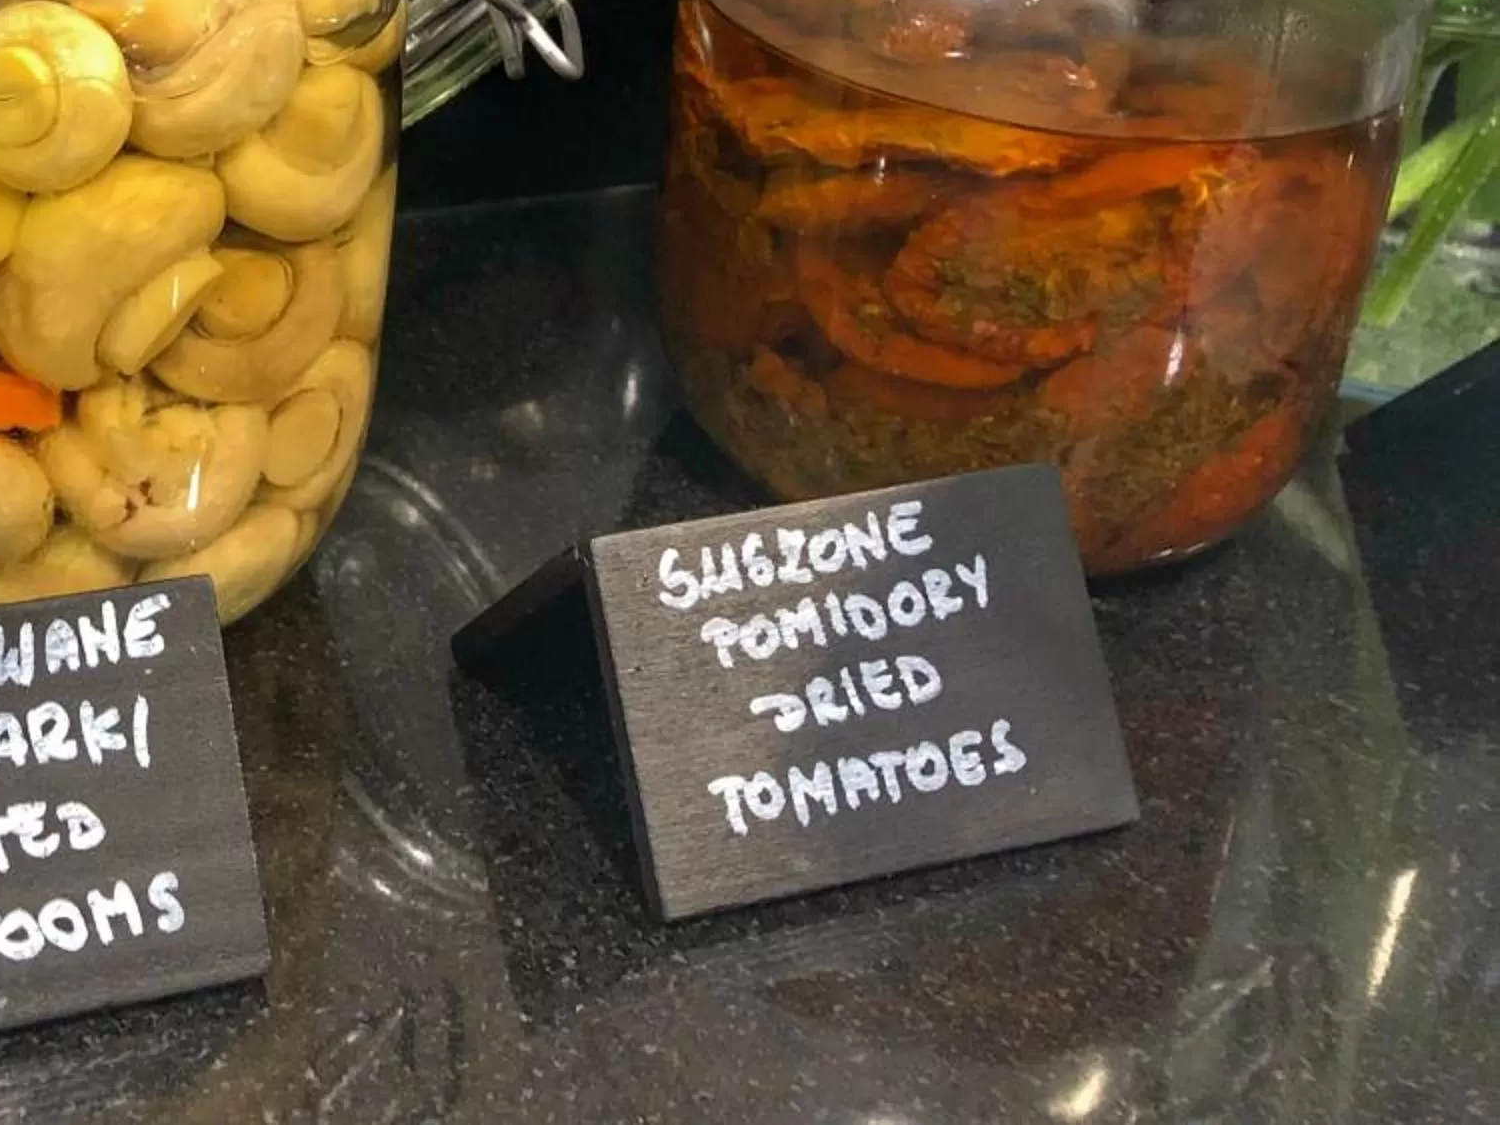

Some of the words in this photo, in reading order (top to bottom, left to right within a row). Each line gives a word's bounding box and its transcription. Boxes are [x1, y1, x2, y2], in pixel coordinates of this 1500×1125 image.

[700, 553, 989, 669] POMIDORY
[749, 655, 943, 733] DRIED
[707, 718, 1028, 836] TOMATOES
